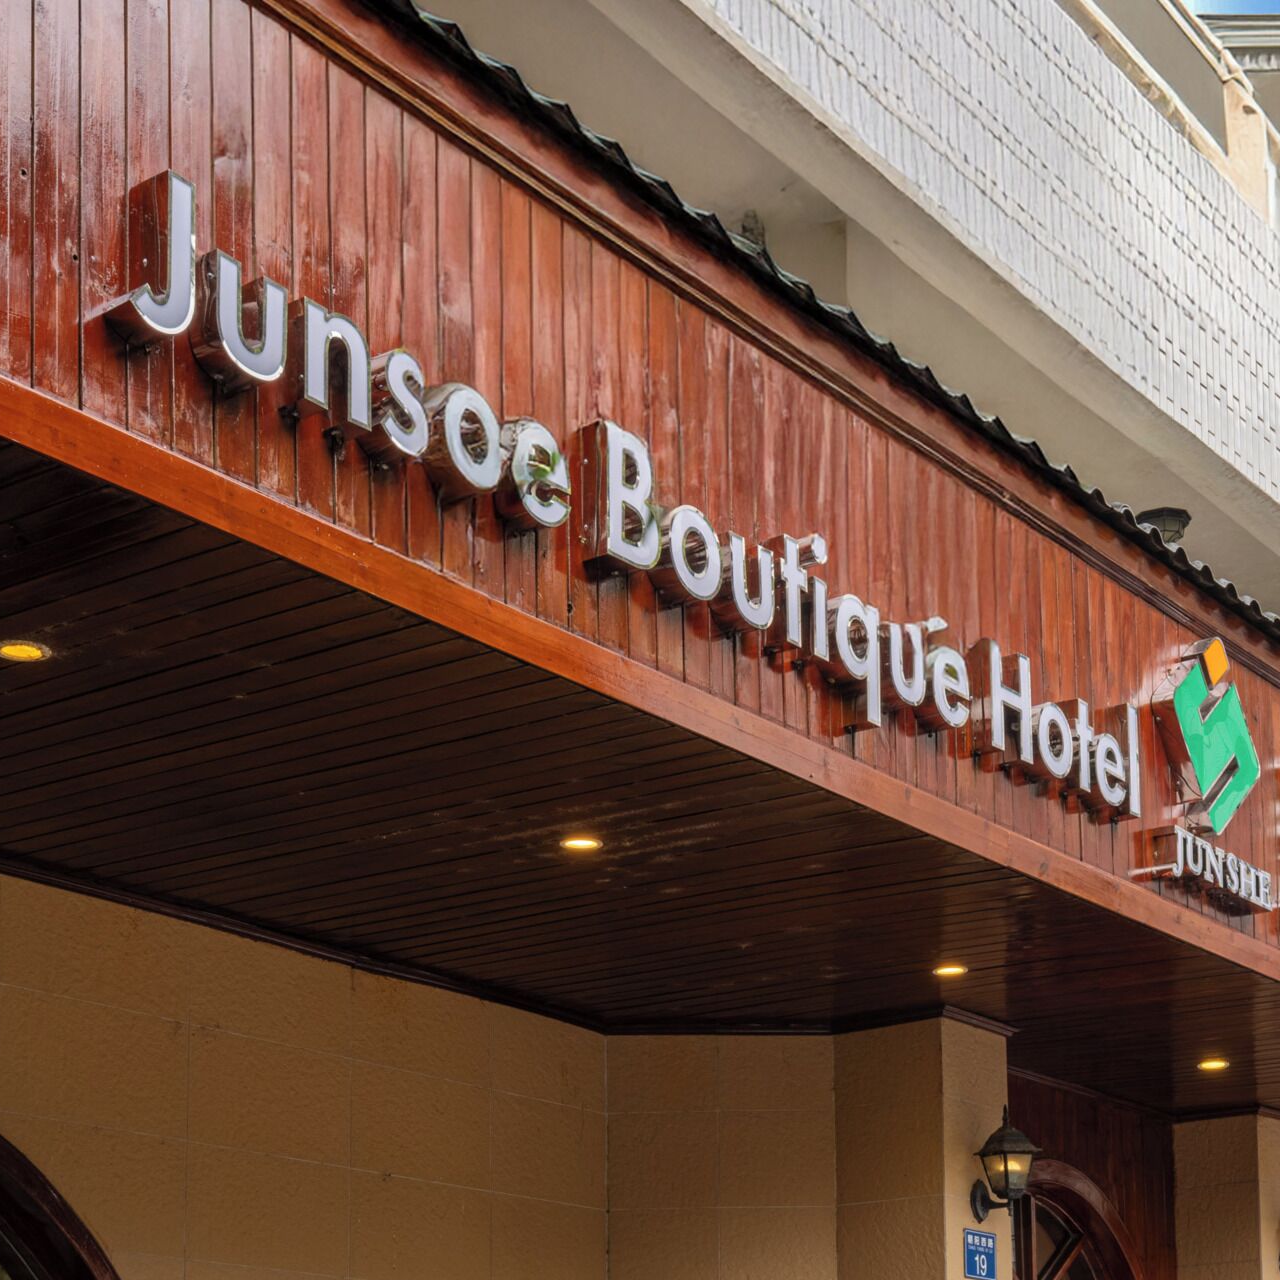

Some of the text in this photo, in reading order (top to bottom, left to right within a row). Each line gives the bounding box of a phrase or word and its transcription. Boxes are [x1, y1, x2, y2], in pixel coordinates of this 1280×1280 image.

[989, 639, 1142, 818] Hotel
[1172, 825, 1273, 912] JUNSHE
[974, 1253, 988, 1277] 19
